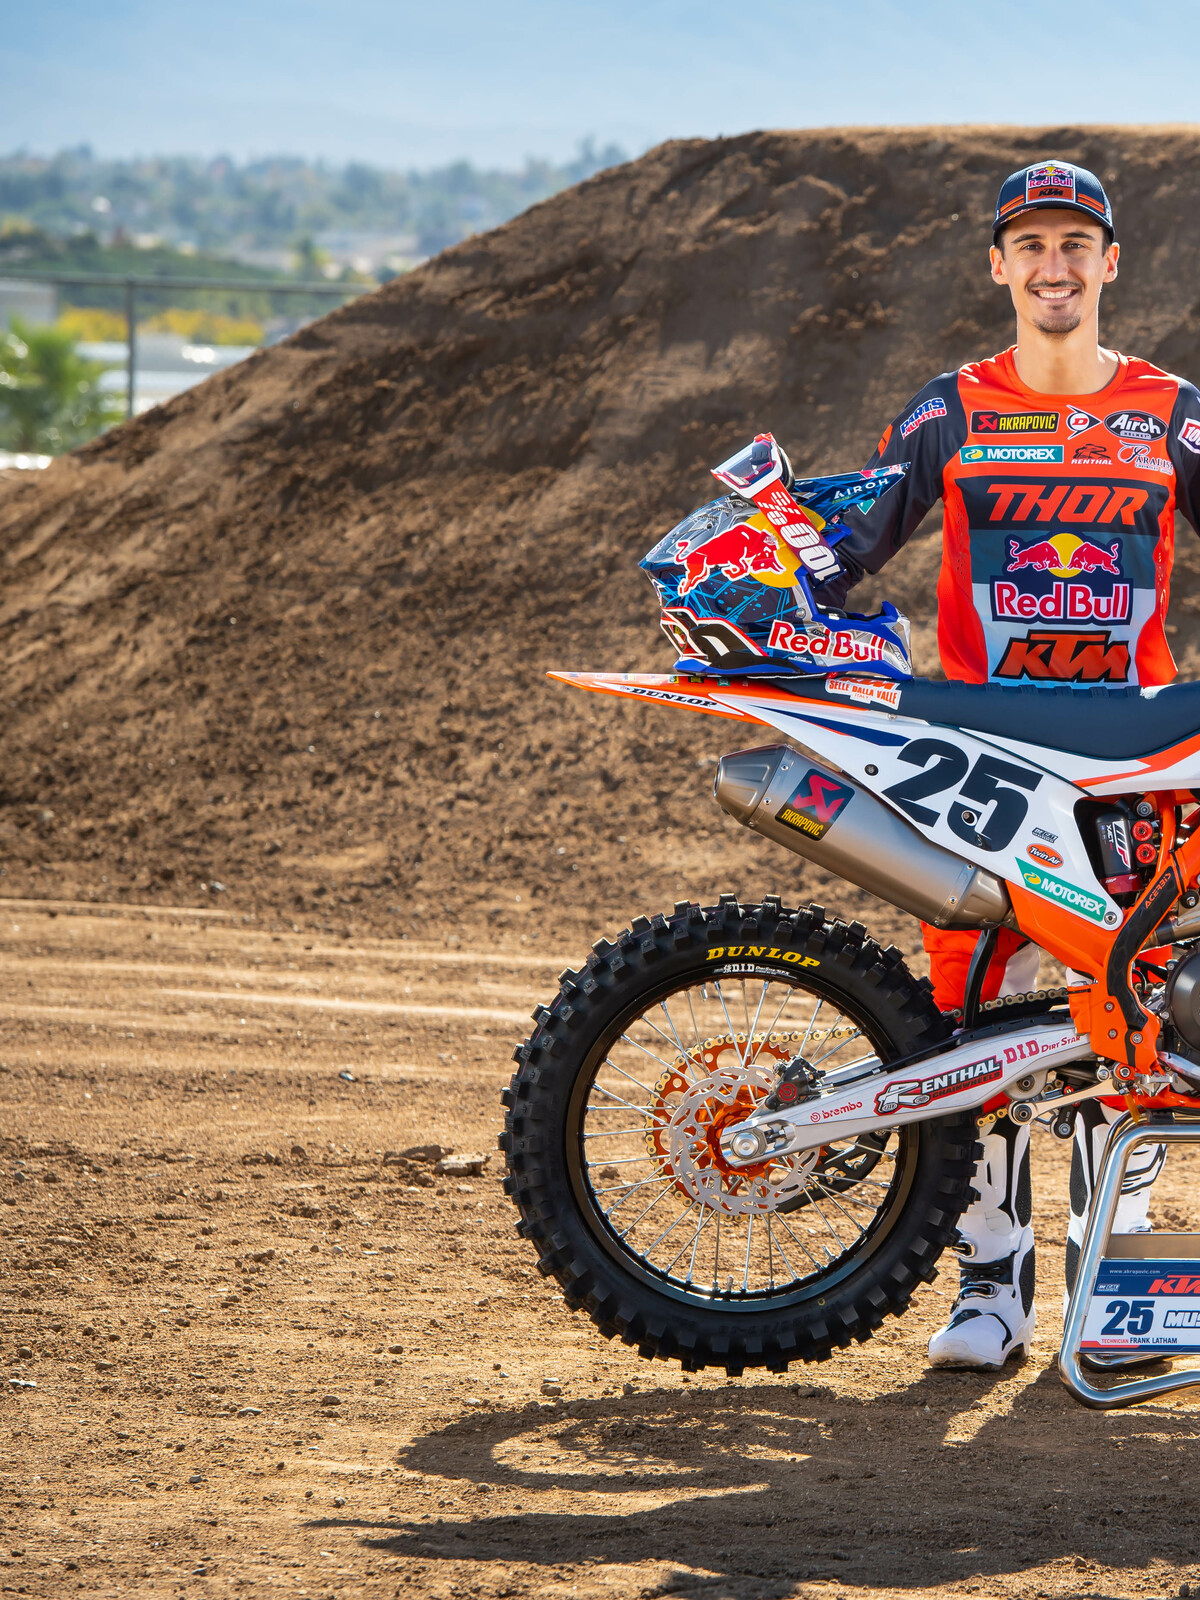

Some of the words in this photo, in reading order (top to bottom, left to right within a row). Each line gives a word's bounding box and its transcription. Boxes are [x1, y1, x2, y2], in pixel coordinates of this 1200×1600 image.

[1029, 176, 1049, 188] Red
[1051, 176, 1072, 187] Bull
[1038, 188, 1063, 196] KTM
[987, 448, 1055, 460] MOTOREX
[834, 478, 888, 500] AIROH
[987, 483, 1149, 525] THOR
[995, 582, 1064, 619] Red
[1067, 583, 1130, 621] Bull
[768, 620, 831, 656] Red
[832, 631, 885, 662] Bull
[995, 630, 1130, 682] KTM
[628, 687, 718, 707] DUNLOP
[828, 680, 849, 691] SELLE
[852, 685, 874, 697] DALLA
[877, 690, 897, 704] VALLE
[881, 738, 1043, 852] 25
[1029, 846, 1048, 861] Twin
[1047, 855, 1063, 866] Air
[1041, 877, 1104, 915] MOTOREX
[706, 946, 820, 968] DUNLOP
[822, 1101, 863, 1119] brembo
[1101, 1300, 1155, 1335] 25
